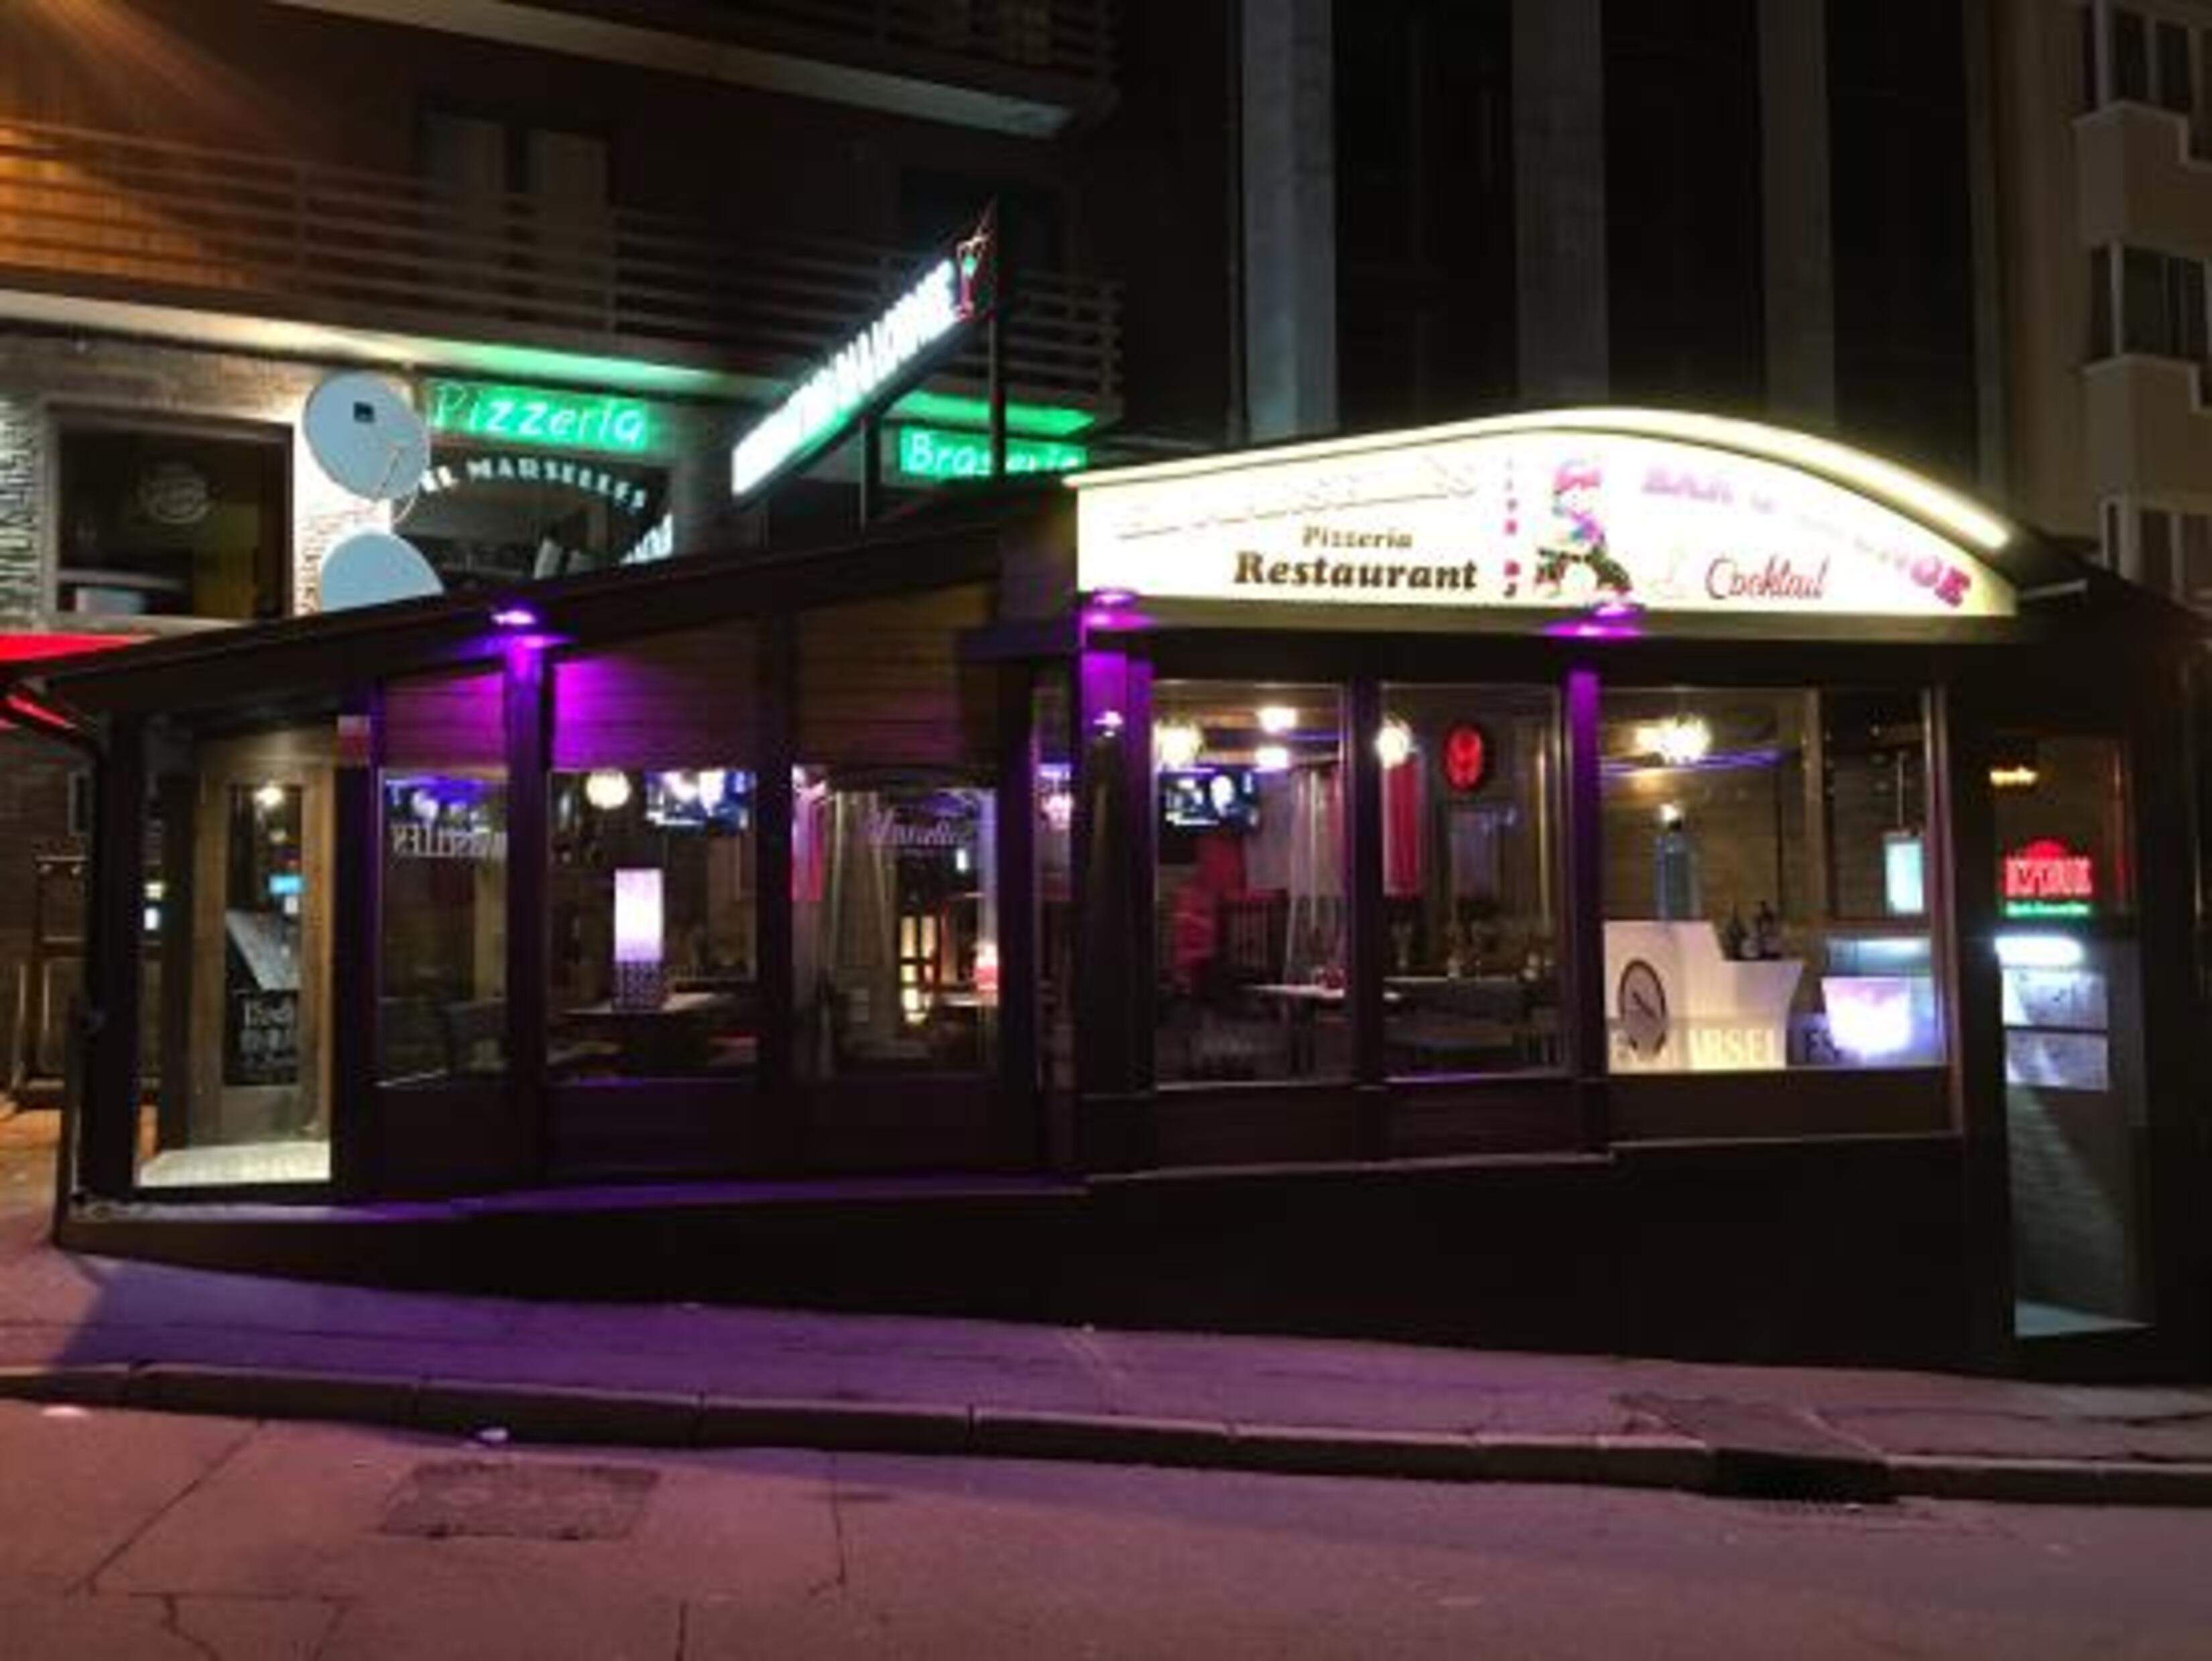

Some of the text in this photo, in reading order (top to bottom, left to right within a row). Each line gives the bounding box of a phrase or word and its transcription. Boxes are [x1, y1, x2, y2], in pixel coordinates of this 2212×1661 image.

[434, 381, 646, 448] Pizzeria
[1302, 525, 1413, 548] Pizzeria
[1233, 549, 1478, 591] Restaurant
[1705, 554, 1831, 599] Cocktail
